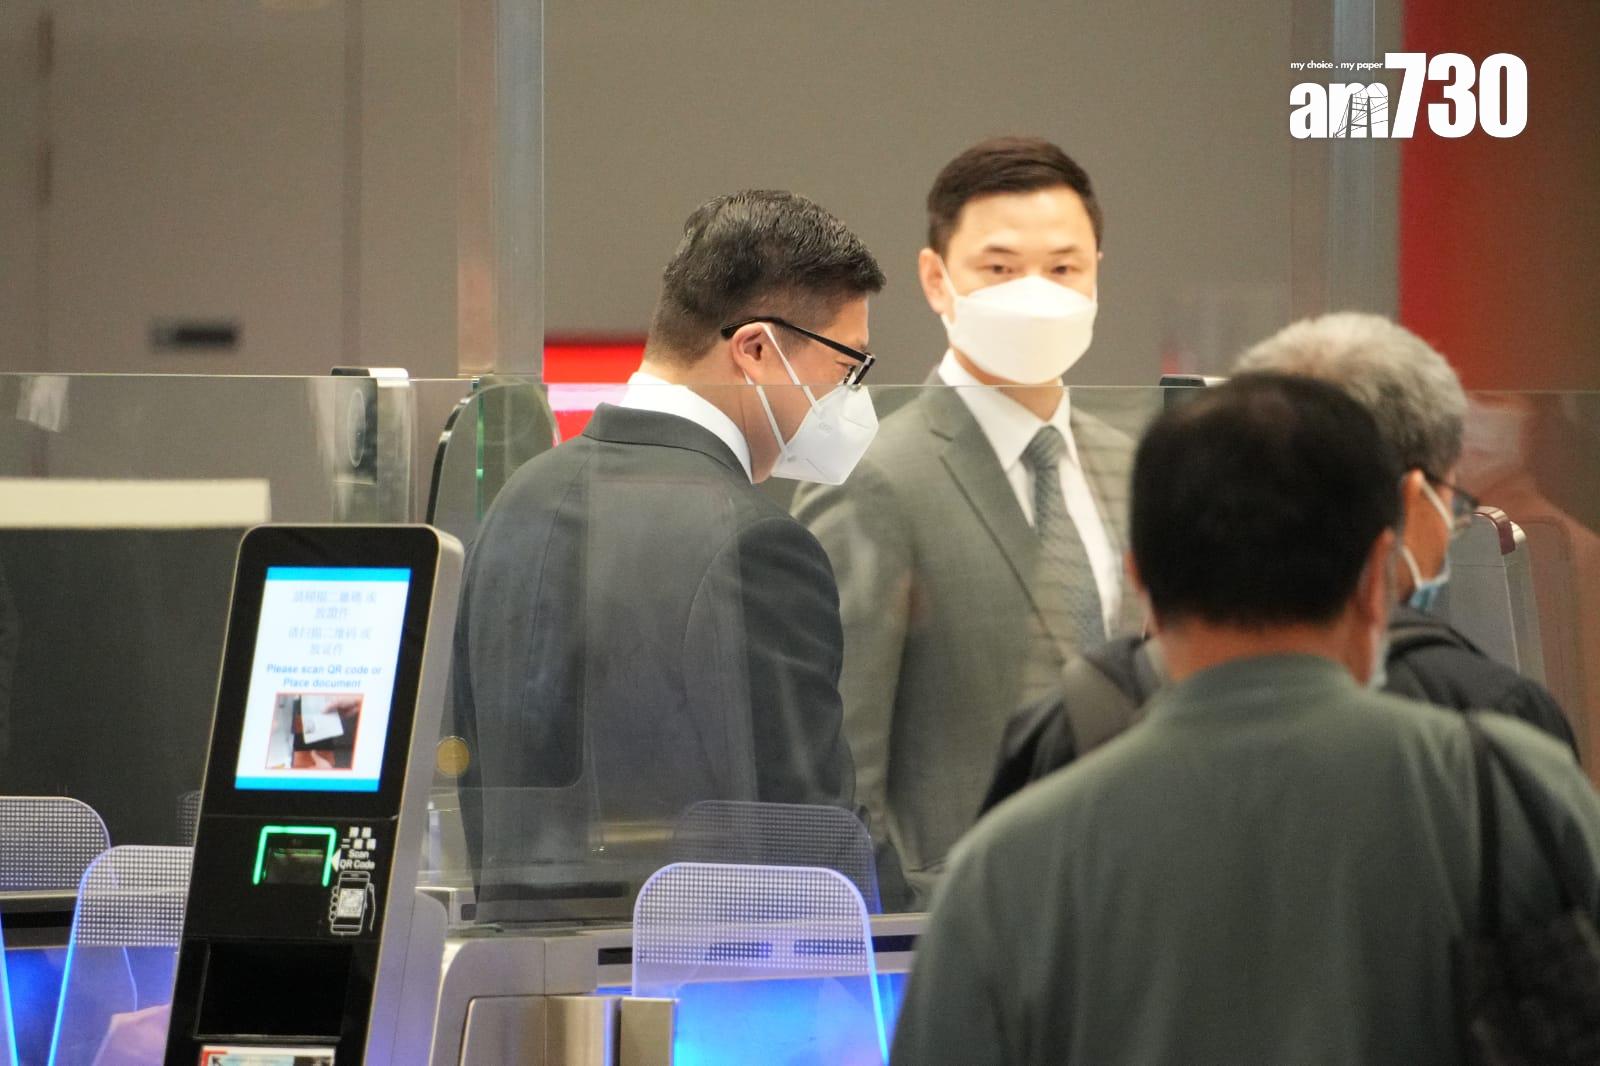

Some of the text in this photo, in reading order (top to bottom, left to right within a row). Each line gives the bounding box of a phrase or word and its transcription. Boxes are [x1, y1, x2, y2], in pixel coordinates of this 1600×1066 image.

[266, 663, 382, 675] Please scan QR code or
[283, 677, 361, 688] Place document
[348, 849, 369, 859] Scan
[339, 859, 376, 870] QR Code
